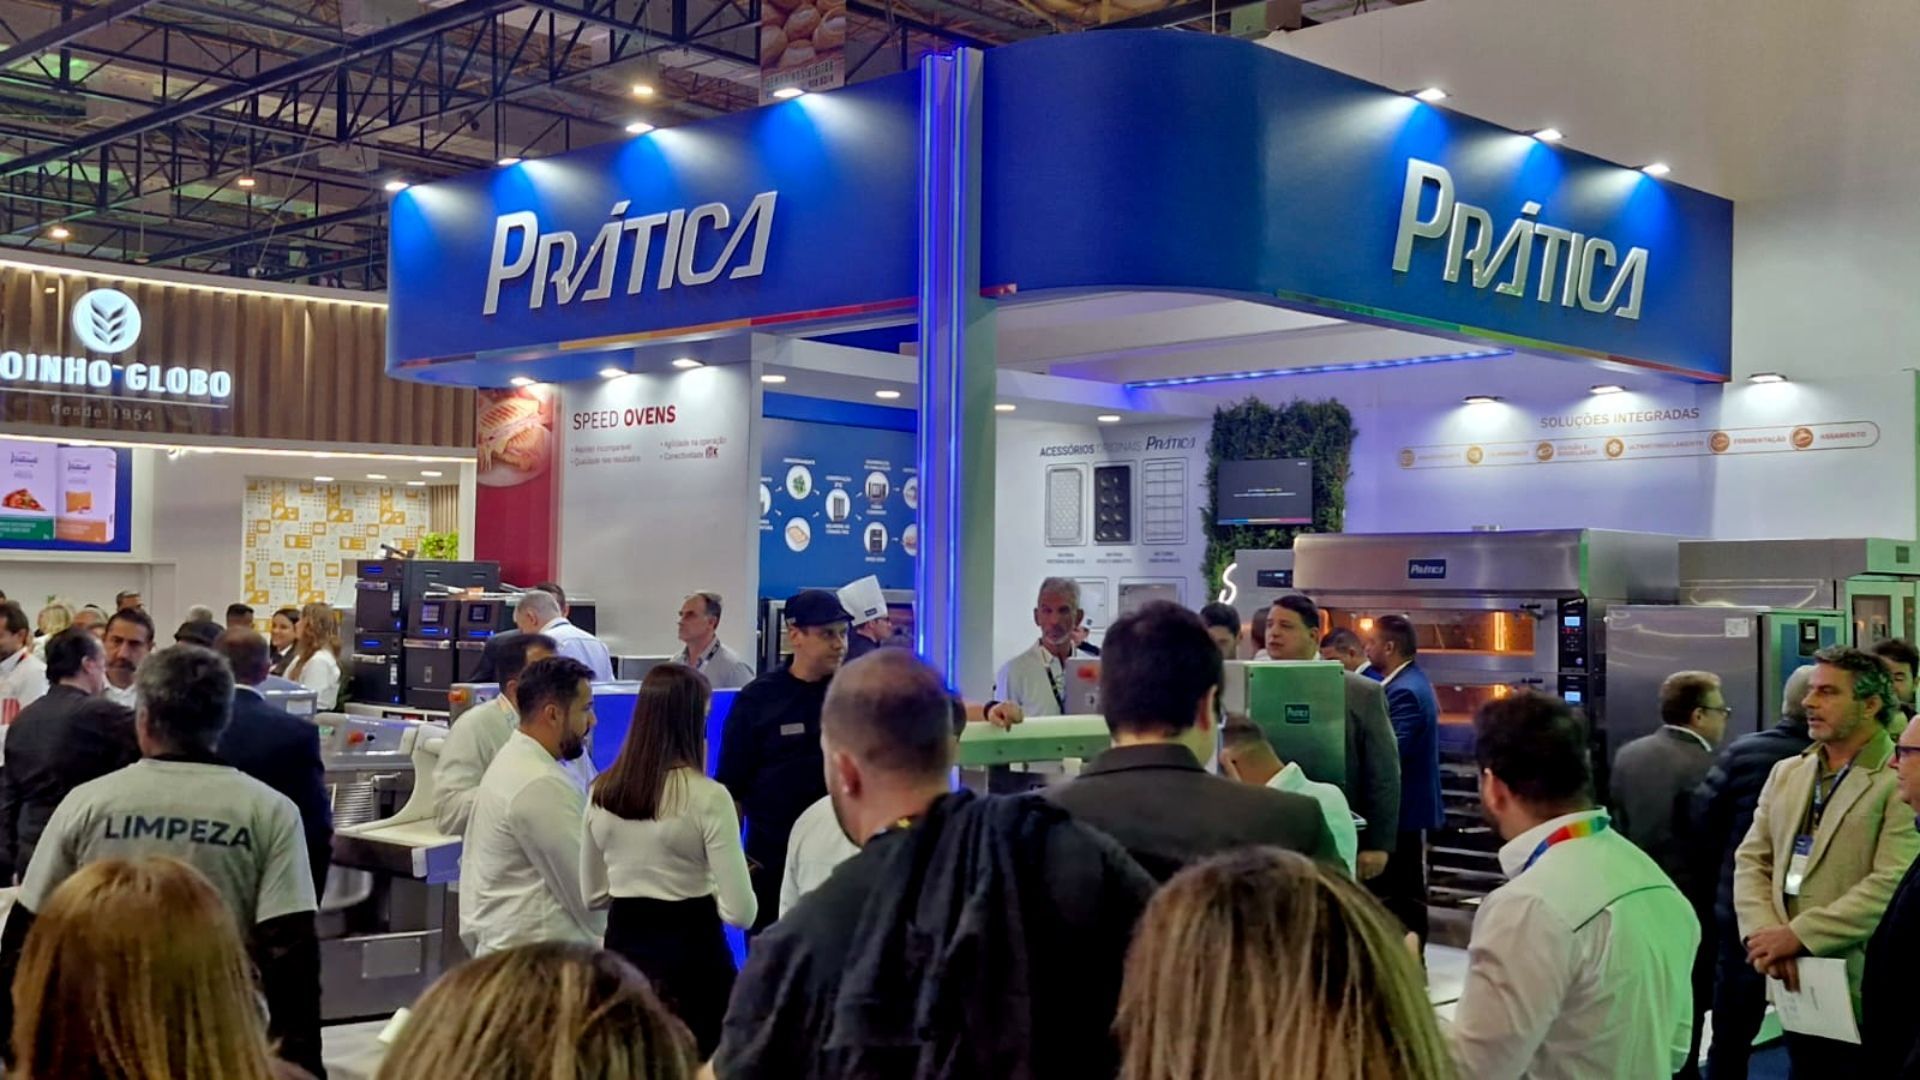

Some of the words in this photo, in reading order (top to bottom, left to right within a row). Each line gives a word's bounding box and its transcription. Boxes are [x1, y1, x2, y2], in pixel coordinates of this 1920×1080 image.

[125, 363, 231, 397] GLOBO
[51, 404, 101, 418] desde
[112, 406, 152, 421] 1954
[573, 410, 619, 430] SPEED
[624, 405, 676, 426] OVENS
[1541, 412, 1609, 429] SOLUÇÕES
[1614, 408, 1699, 423] INTEGRADAS
[1040, 444, 1095, 457] ACESSÓRIOS
[105, 815, 253, 852] LIMPEZA
